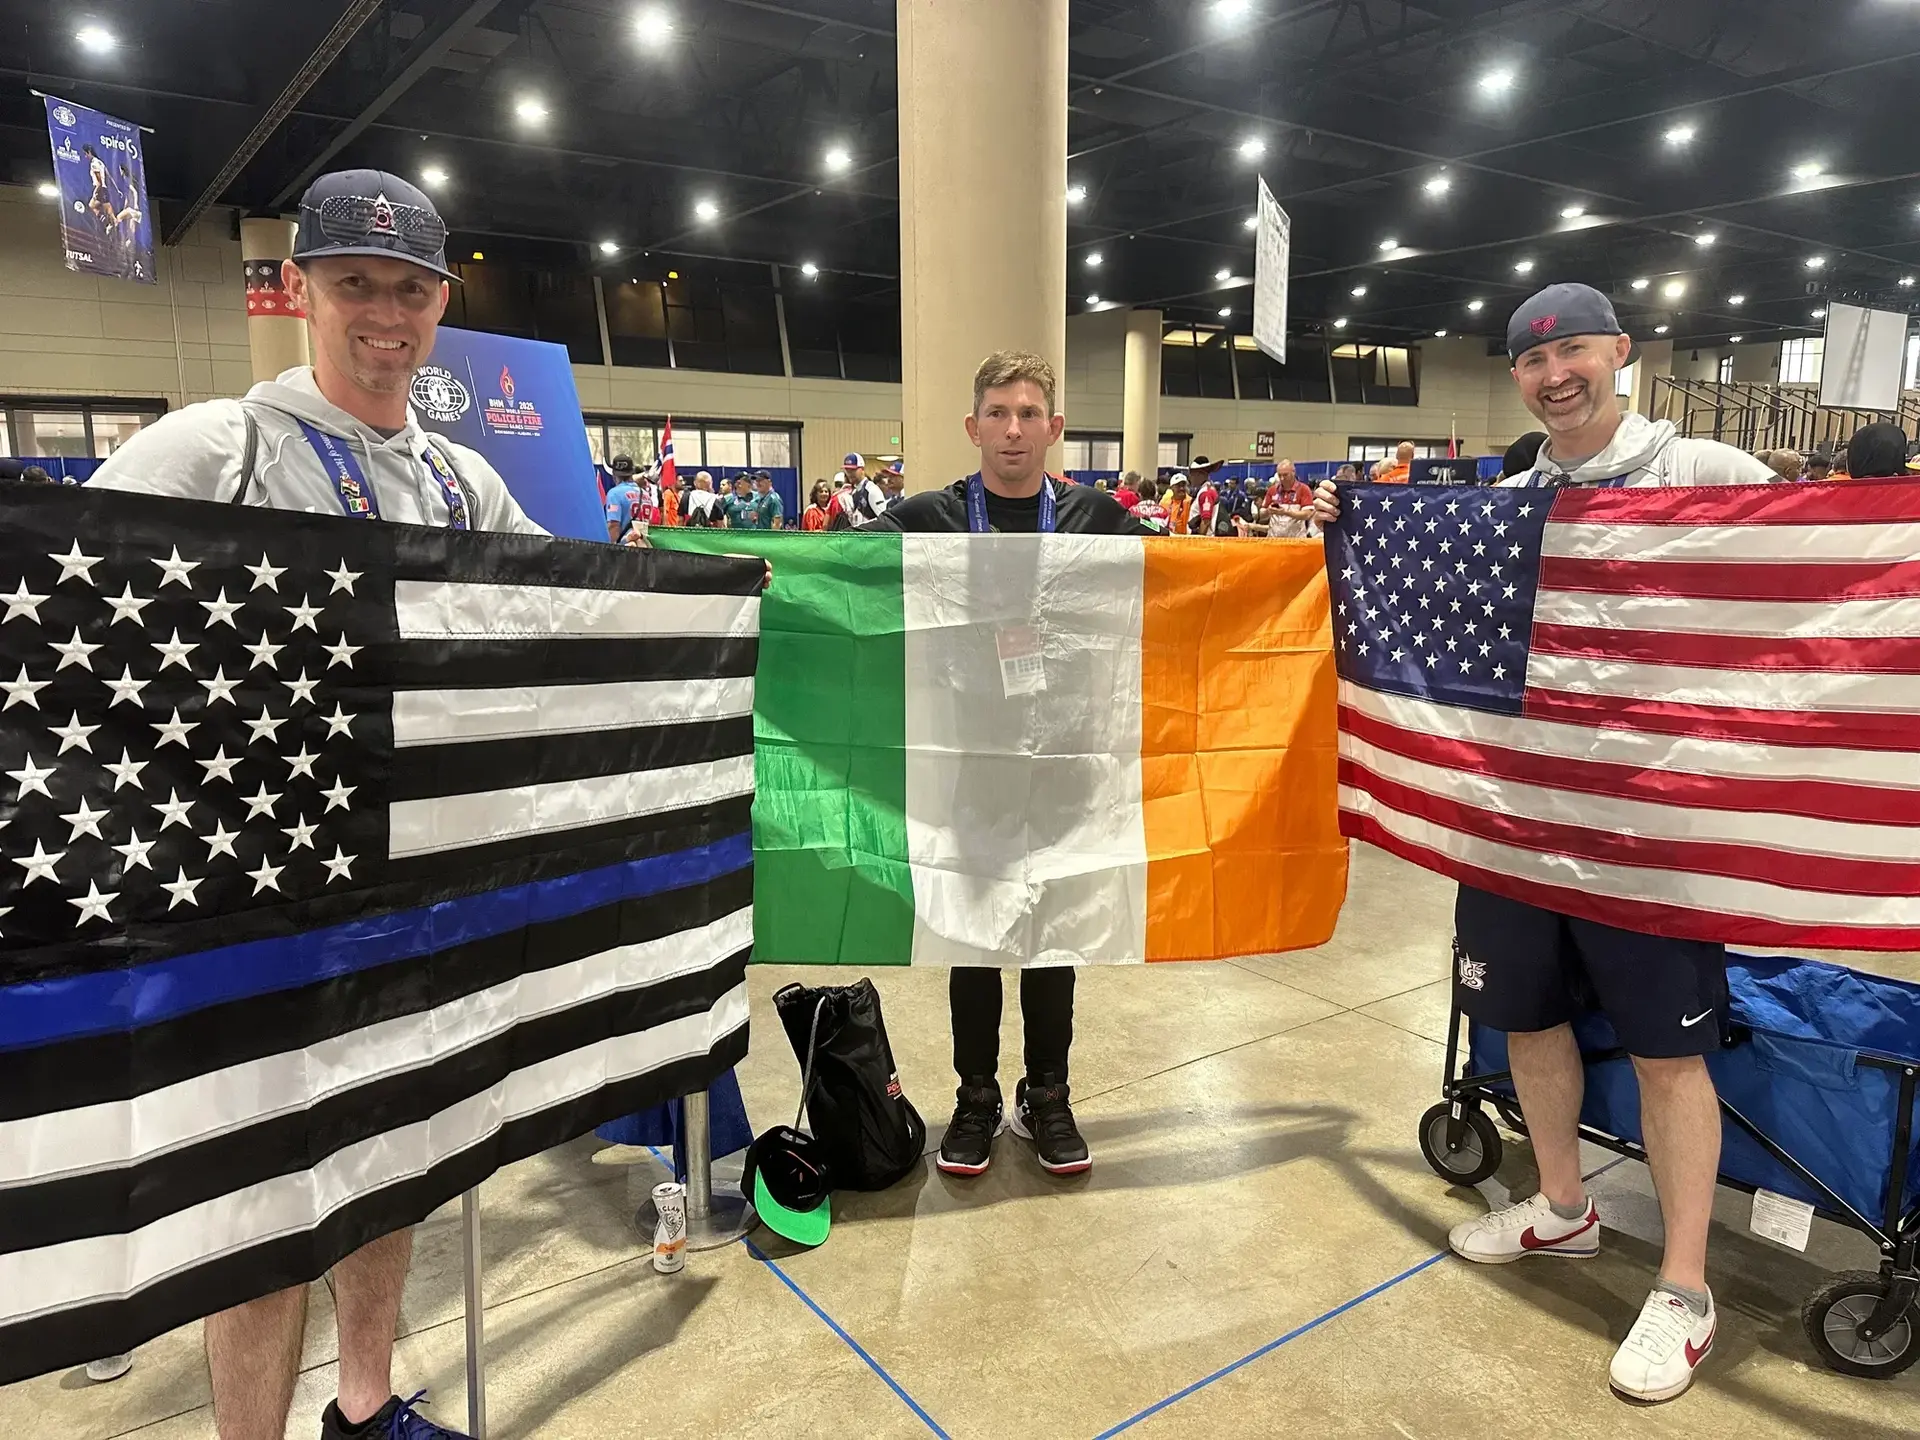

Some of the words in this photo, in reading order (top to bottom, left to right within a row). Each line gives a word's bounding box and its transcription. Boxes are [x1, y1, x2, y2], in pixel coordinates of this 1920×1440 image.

[100, 135, 125, 150] spire
[66, 250, 93, 262] FUTSAL
[417, 366, 452, 379] WORLD
[427, 409, 461, 422] GAMES
[486, 412, 516, 424] POLICE
[523, 415, 542, 425] FIRE
[1258, 434, 1273, 444] Fire
[1257, 444, 1273, 454] Exit
